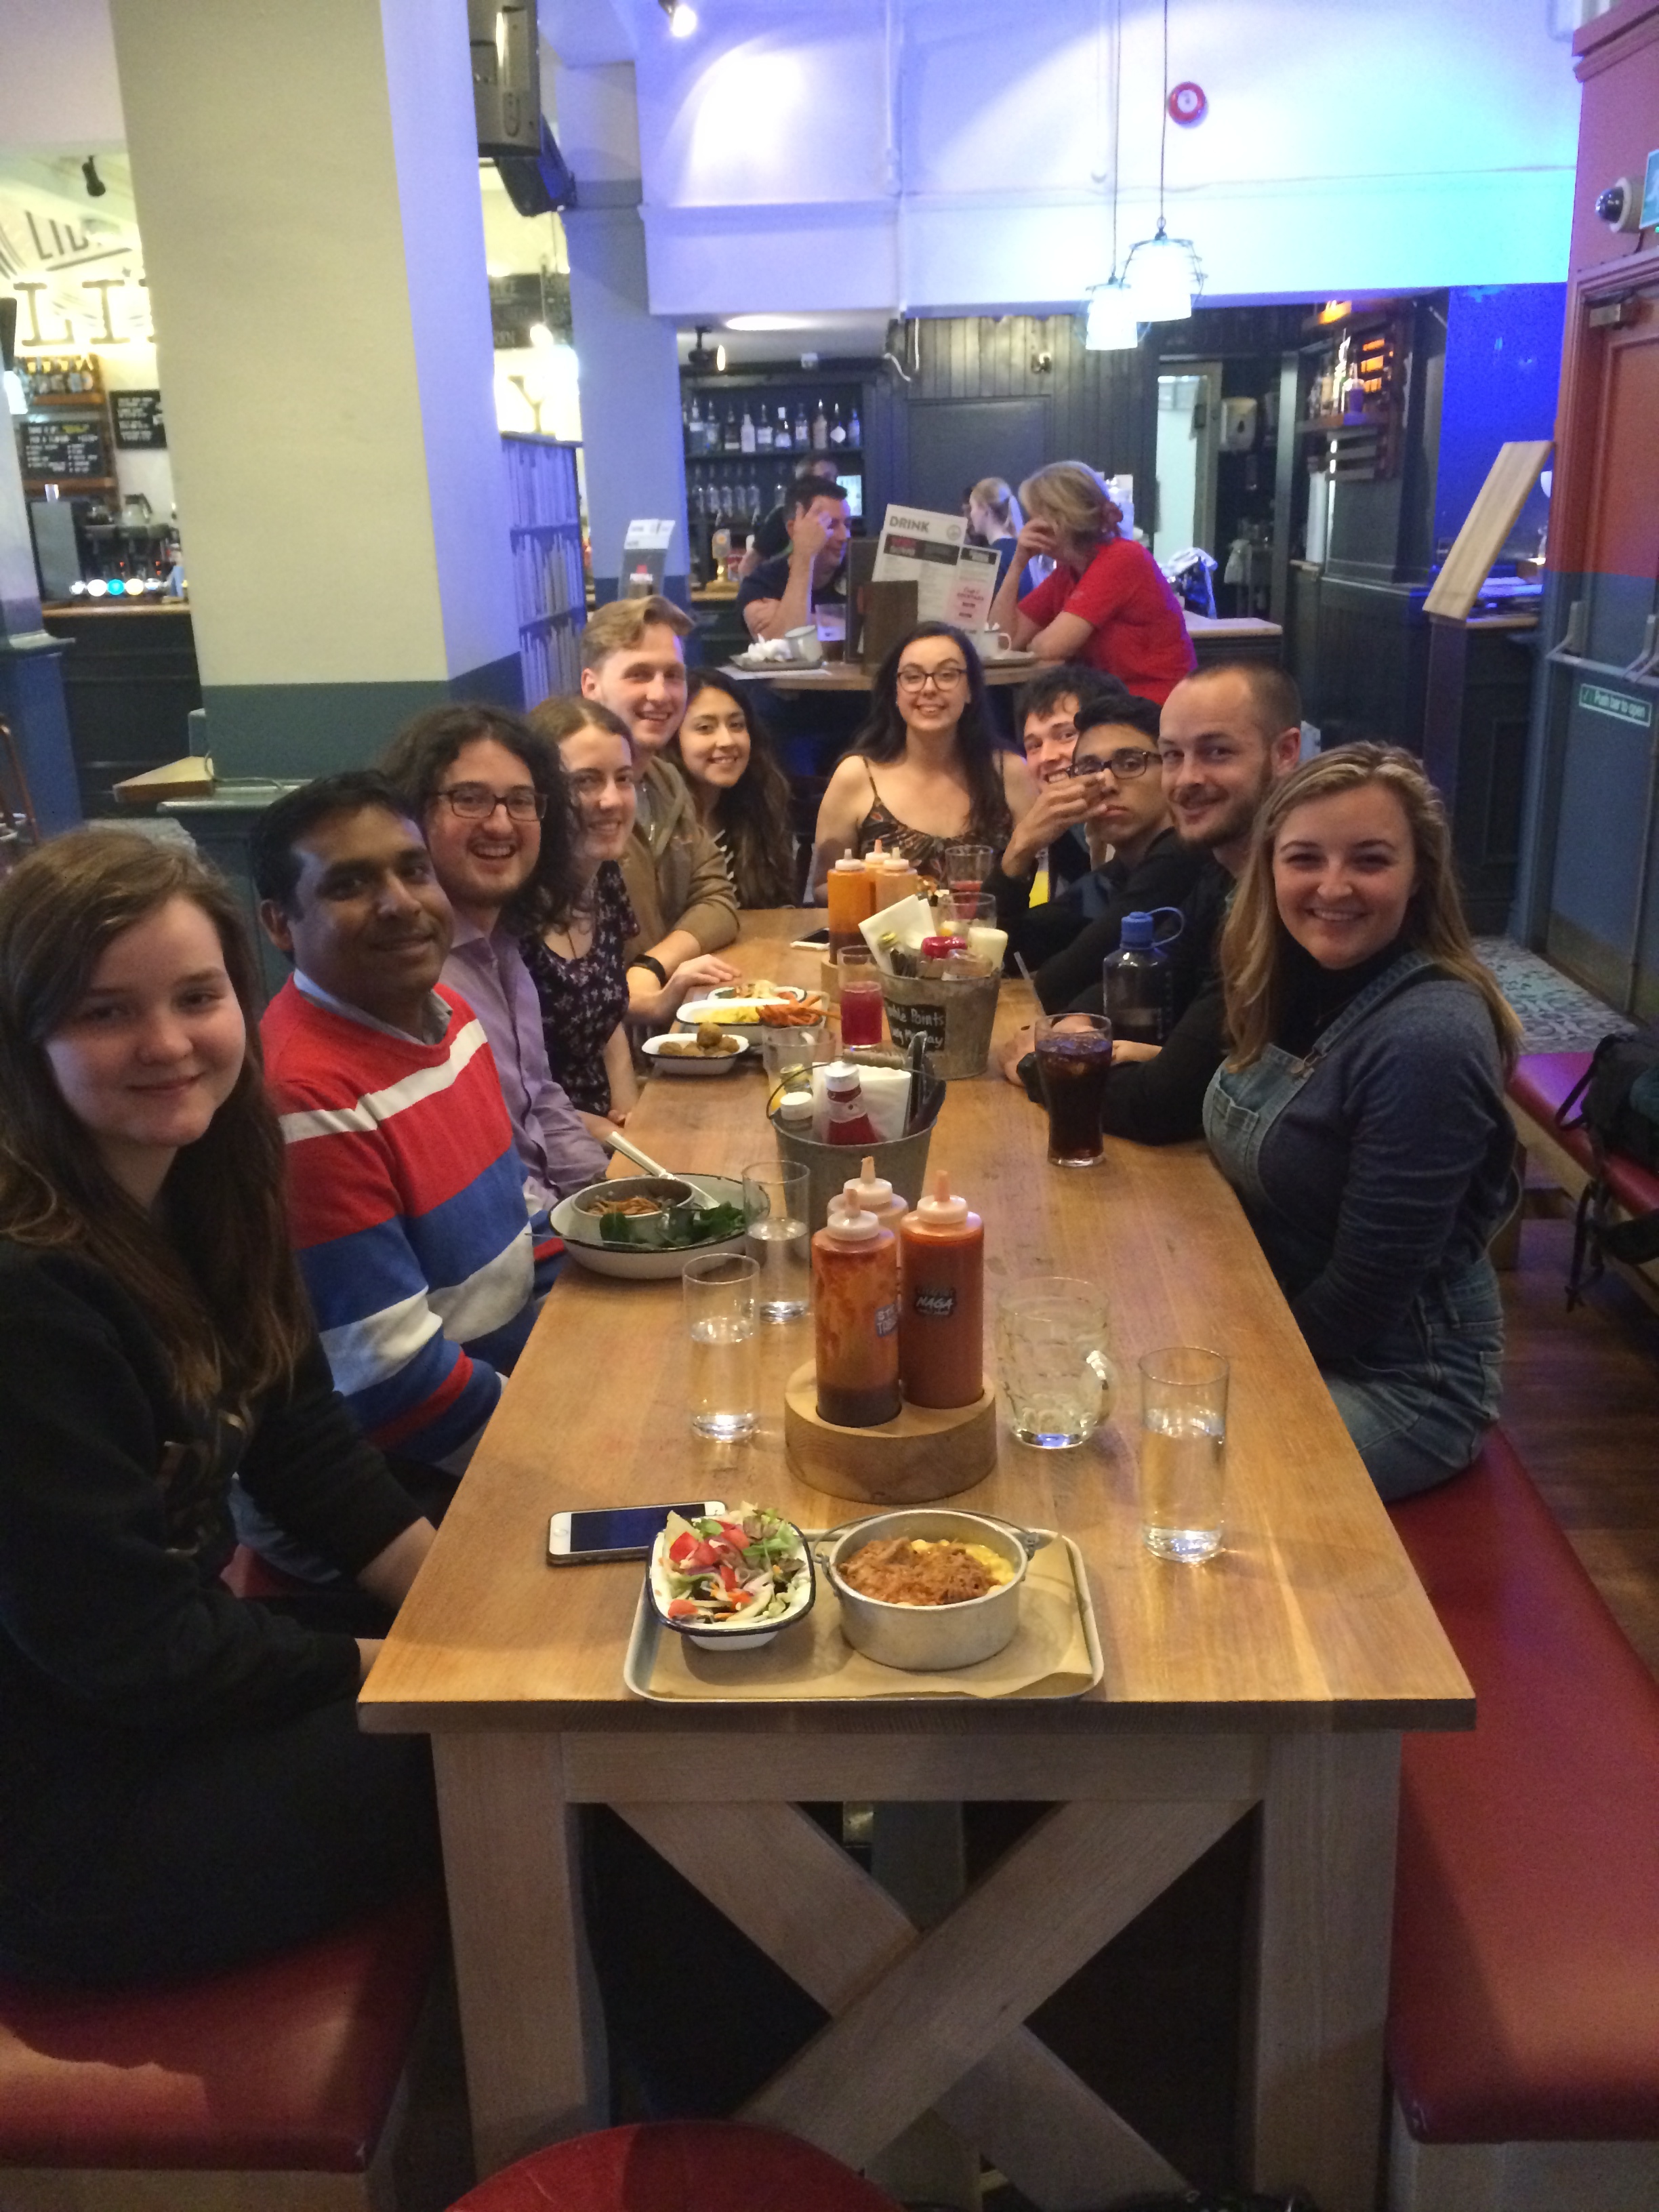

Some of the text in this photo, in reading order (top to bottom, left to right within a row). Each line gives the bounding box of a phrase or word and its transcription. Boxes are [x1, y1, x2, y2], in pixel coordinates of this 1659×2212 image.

[889, 515, 930, 533] DRINK
[911, 1008, 945, 1027] Points
[916, 1296, 954, 1310] NAGA
